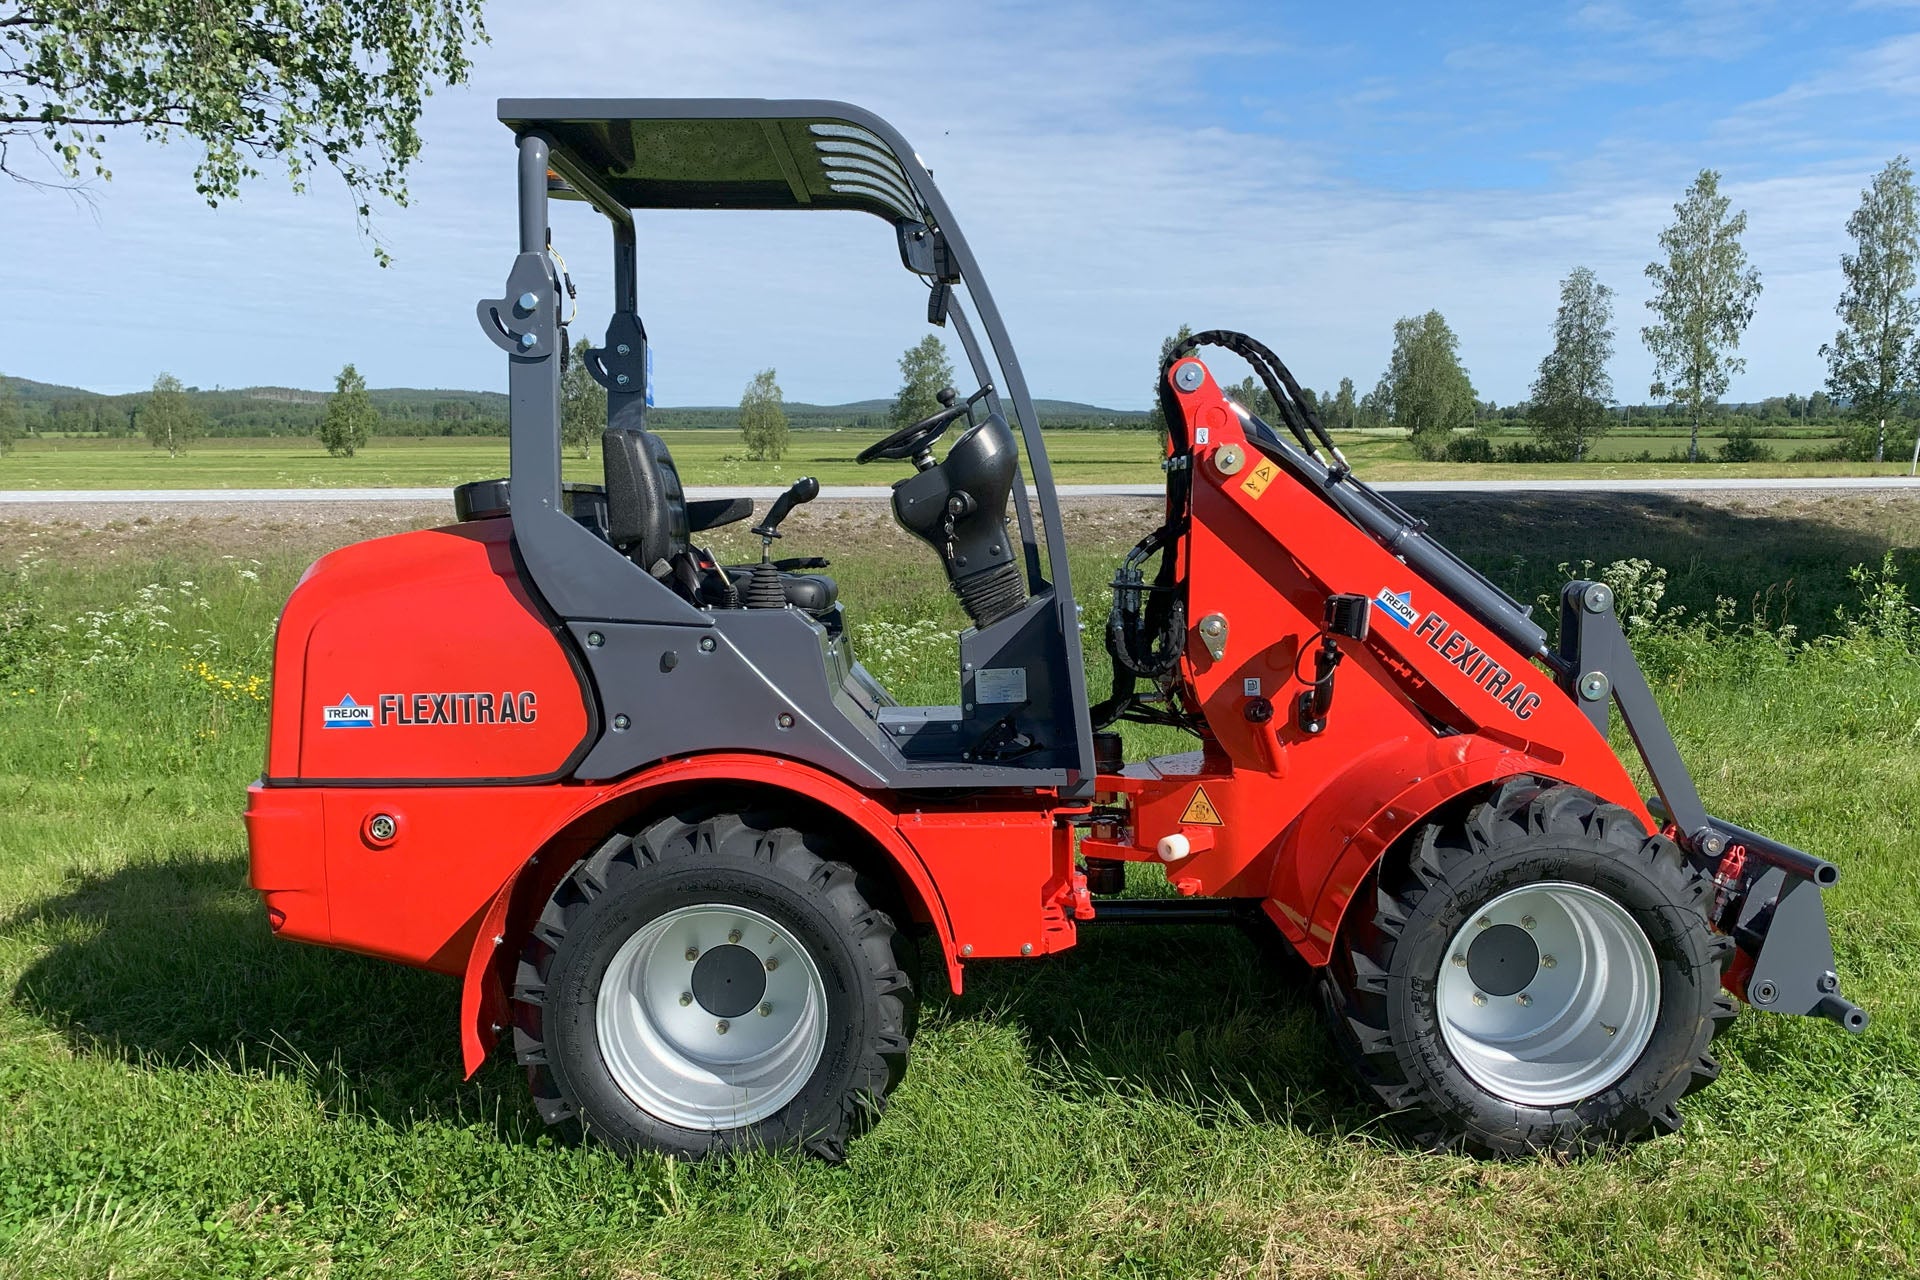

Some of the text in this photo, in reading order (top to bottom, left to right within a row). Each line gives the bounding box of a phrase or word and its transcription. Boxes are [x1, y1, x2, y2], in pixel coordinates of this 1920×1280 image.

[1382, 590, 1541, 720] TREJON FLEXITRAC
[327, 691, 536, 725] TREJON FLEXITRAC
